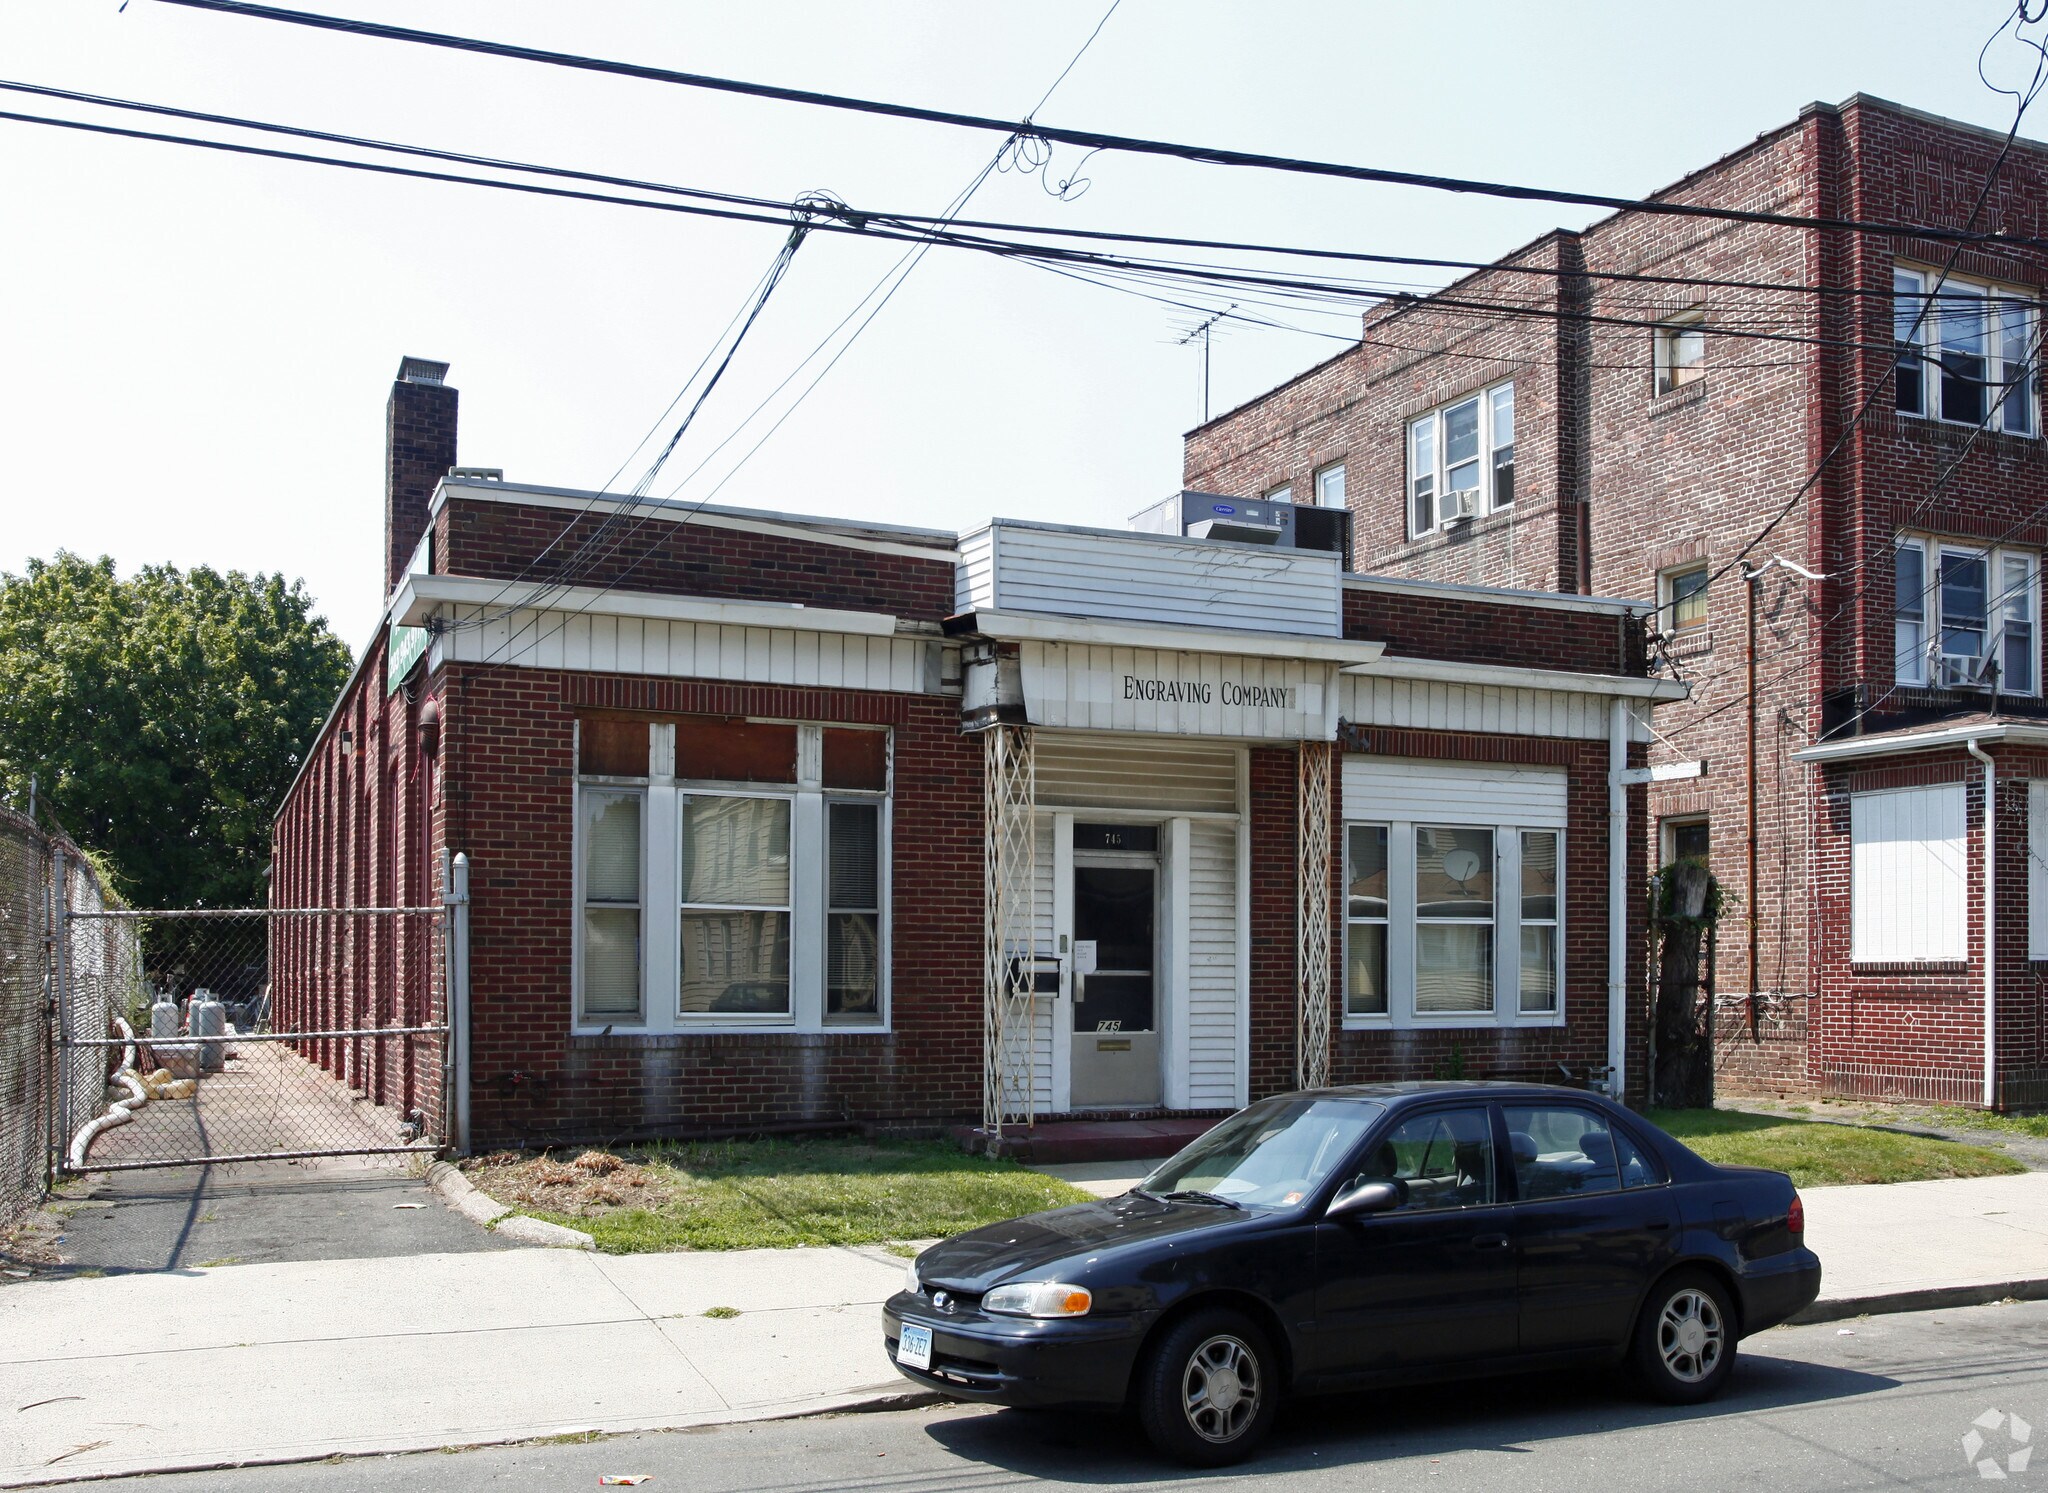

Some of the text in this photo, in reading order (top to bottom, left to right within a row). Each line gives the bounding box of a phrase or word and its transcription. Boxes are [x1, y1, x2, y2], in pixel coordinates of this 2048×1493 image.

[1123, 676, 1288, 709] ENGRAVING COMPANY
[1105, 833, 1121, 844] 745
[1098, 1021, 1120, 1031] 745
